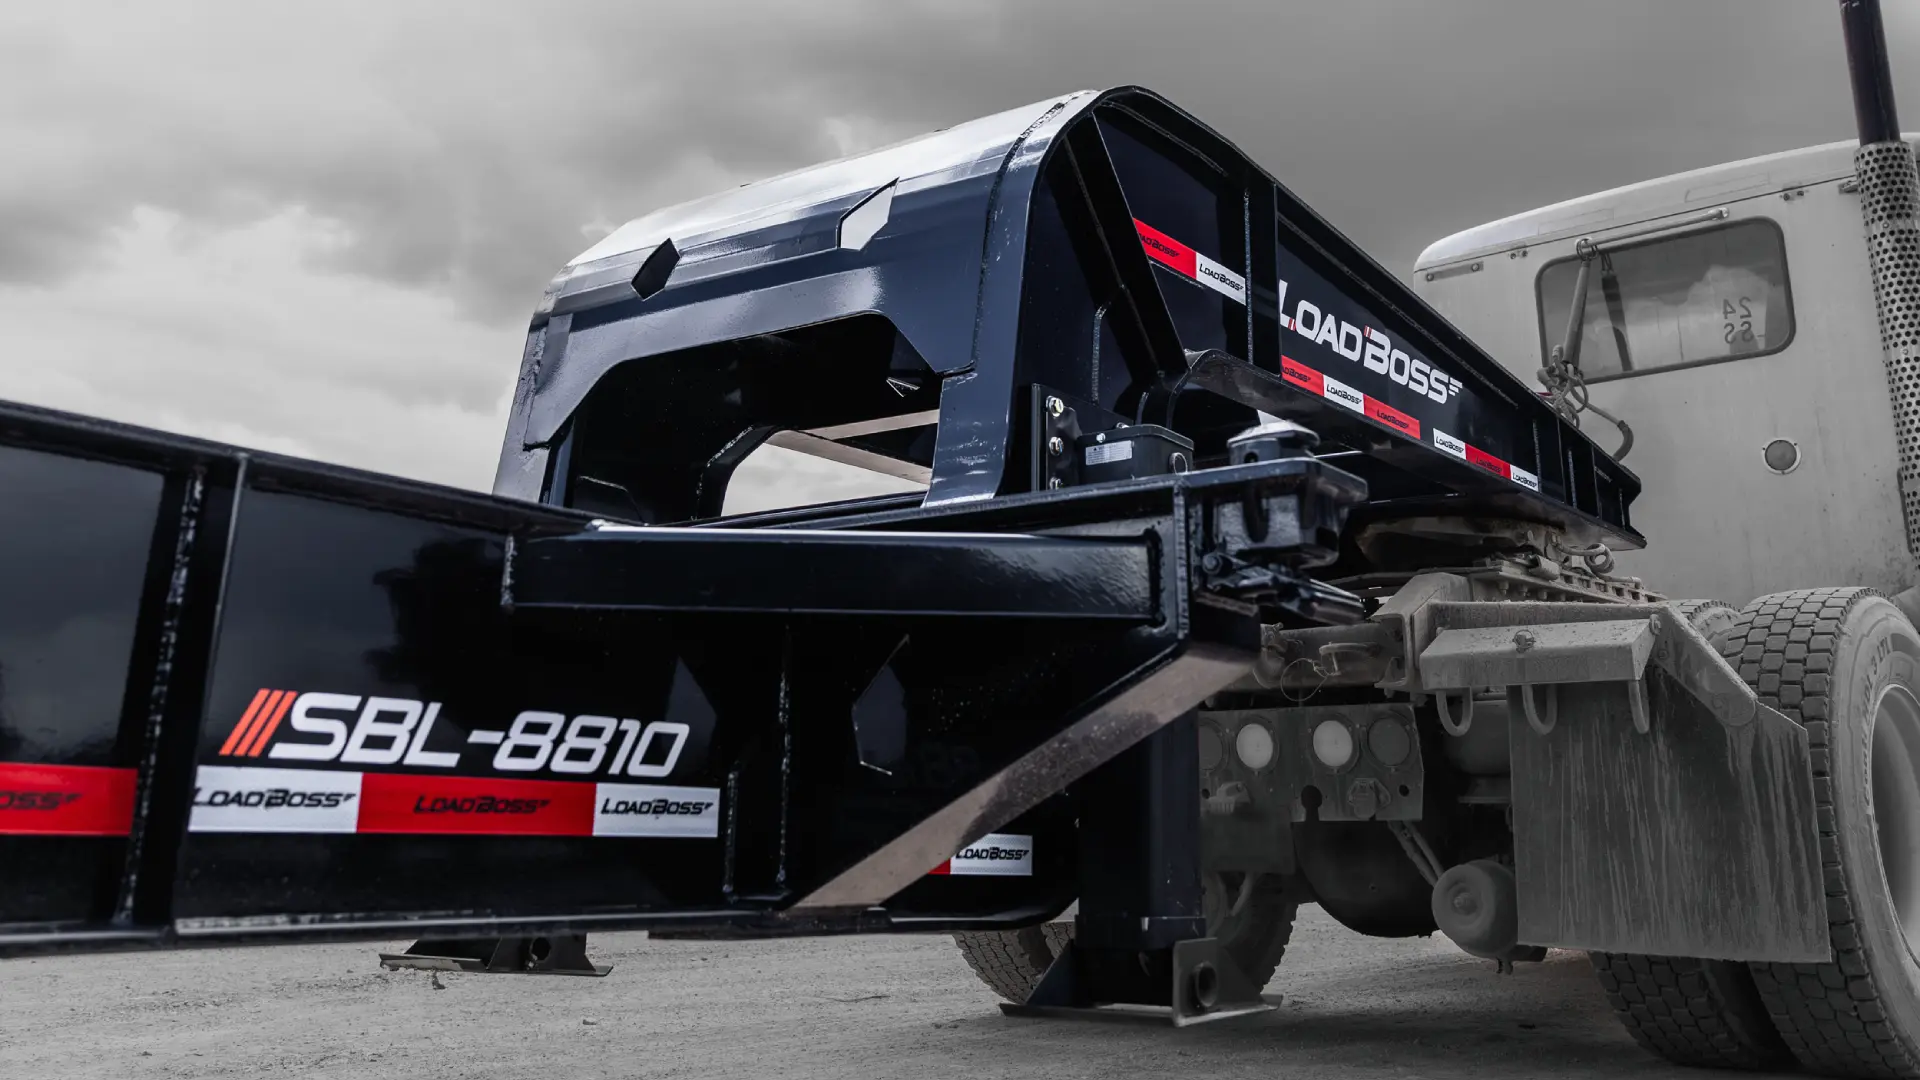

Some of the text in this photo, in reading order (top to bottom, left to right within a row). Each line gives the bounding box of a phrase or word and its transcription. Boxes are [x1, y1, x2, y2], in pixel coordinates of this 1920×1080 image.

[1139, 233, 1178, 257] ADBOSS
[1200, 263, 1243, 291] LOADBOSS
[1279, 279, 1452, 404] LOADBOSS
[1327, 383, 1361, 404] LOADBOSS
[268, 691, 690, 778] SBL-8810
[0, 790, 63, 811] OSS
[414, 793, 542, 814] LOADBOSS
[601, 797, 706, 816] LOADBOSS
